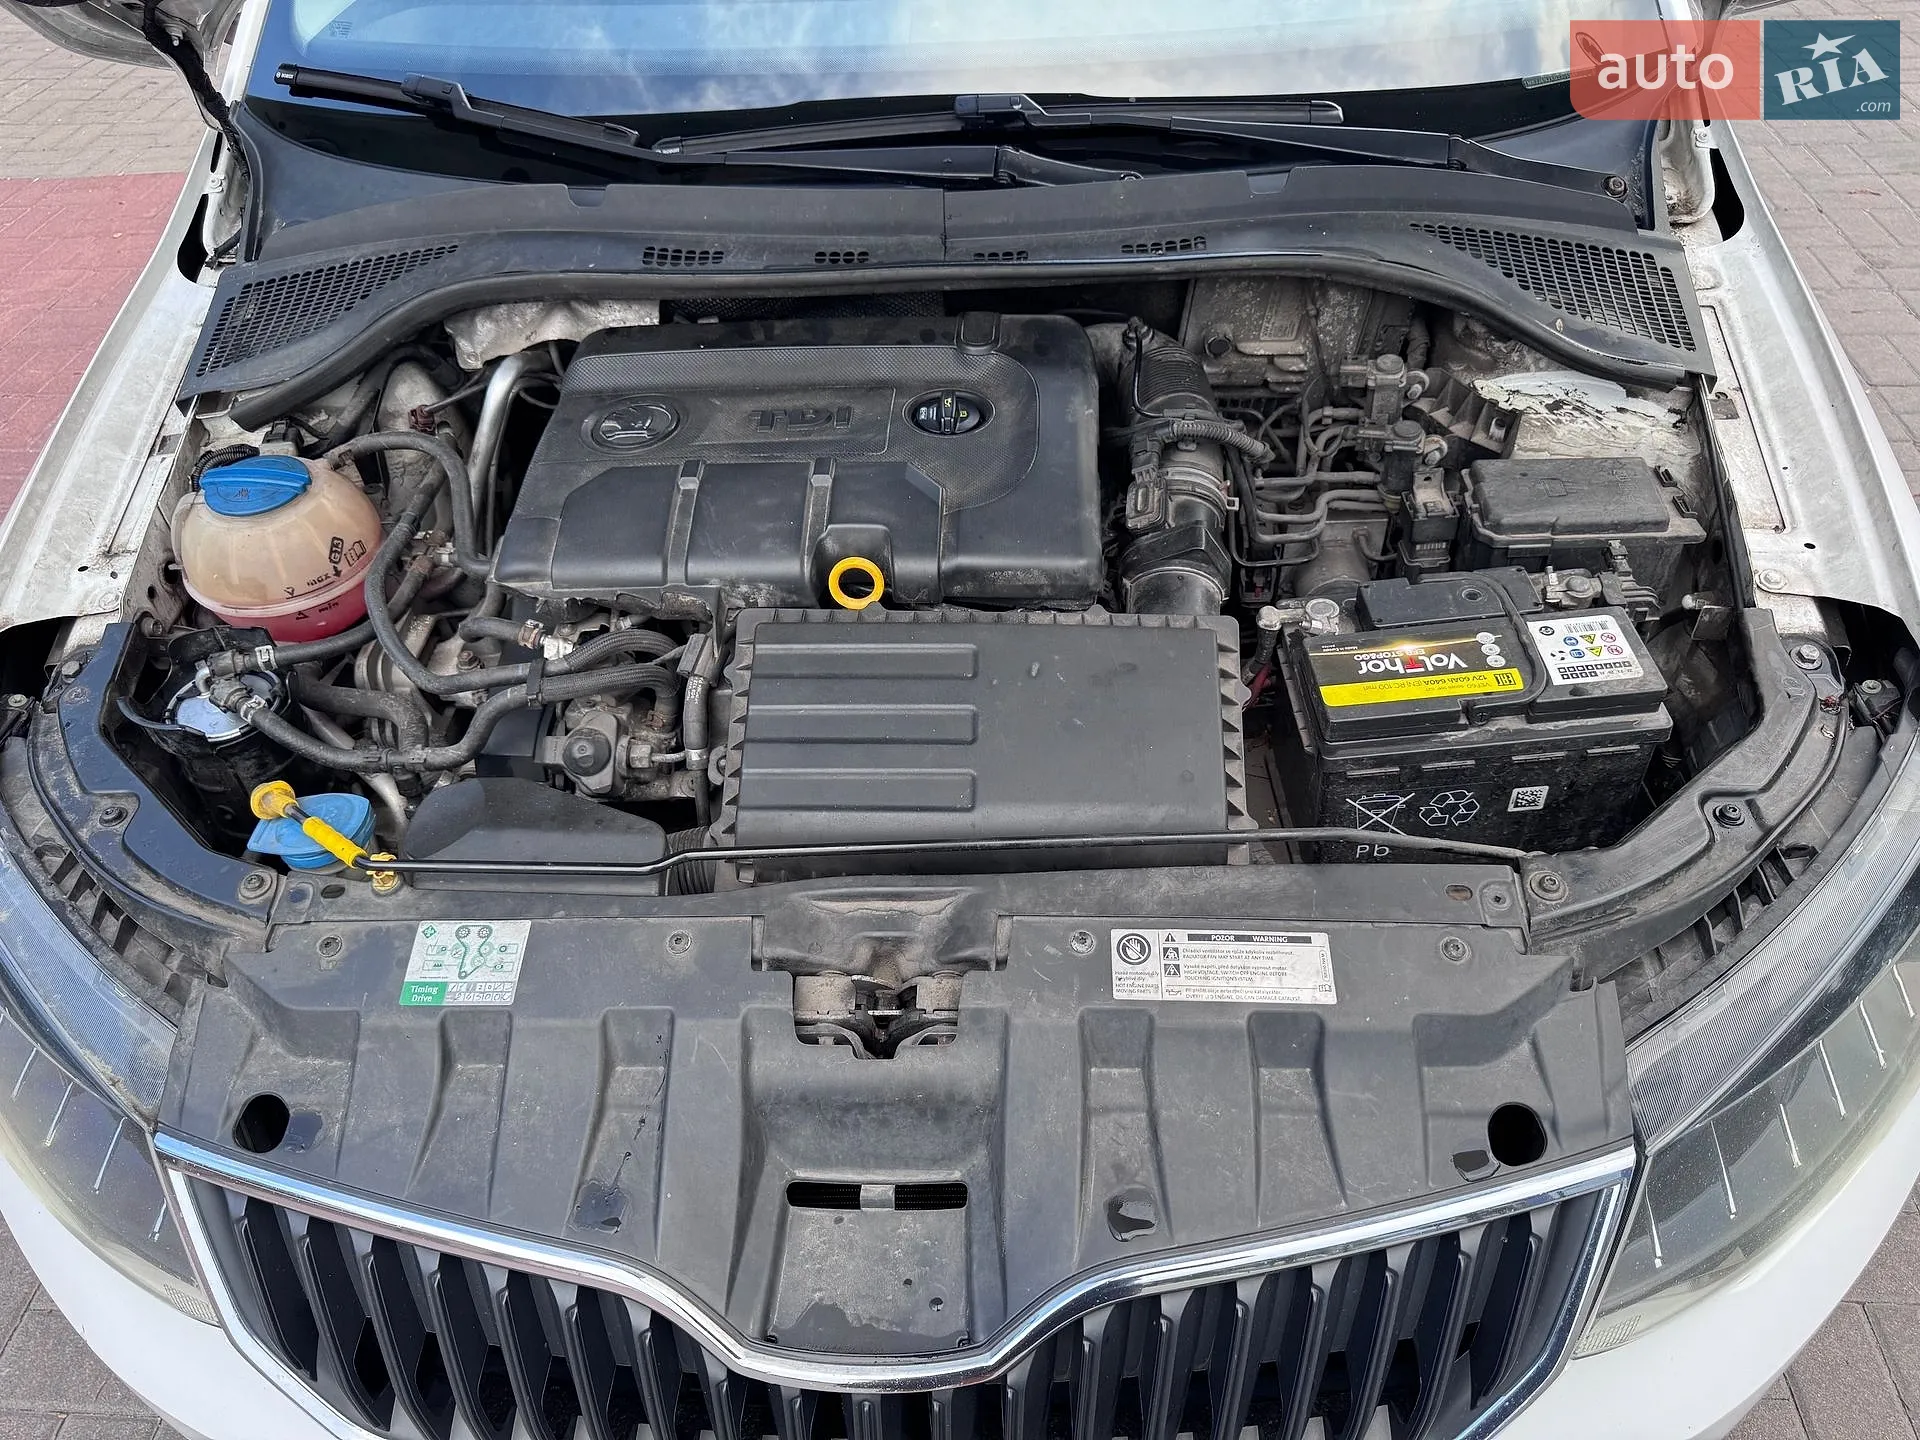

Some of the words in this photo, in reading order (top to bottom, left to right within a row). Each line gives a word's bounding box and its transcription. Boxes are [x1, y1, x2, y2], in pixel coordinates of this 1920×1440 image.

[749, 406, 852, 432] TDI
[318, 601, 340, 613] min
[1356, 652, 1468, 675] VolThor
[1423, 677, 1446, 686] 640A
[1447, 675, 1470, 683] 60Ah
[1471, 674, 1487, 682] 12V
[1356, 844, 1389, 858] Pb
[1252, 935, 1288, 943] WARNING
[410, 985, 439, 995] Timing
[411, 994, 433, 1002] Drive
